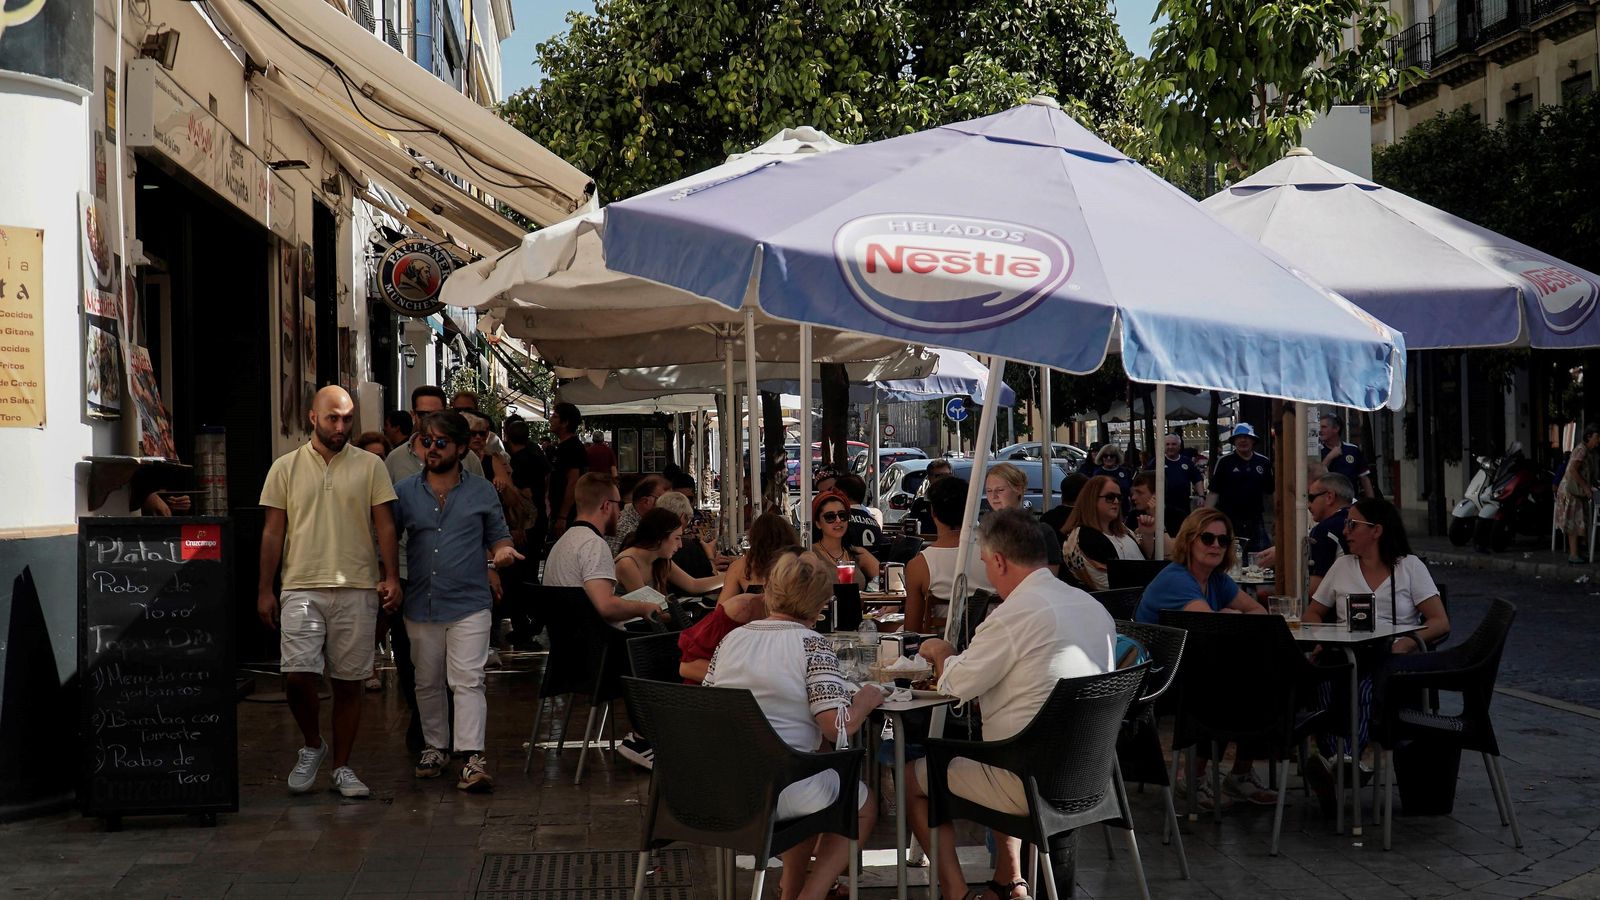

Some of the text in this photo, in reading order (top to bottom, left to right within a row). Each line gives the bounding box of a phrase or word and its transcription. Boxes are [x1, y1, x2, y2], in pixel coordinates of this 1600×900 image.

[888, 220, 1027, 243] HELADOS
[388, 243, 452, 280] PAULANER
[384, 283, 439, 310] MÜNCHEN
[5, 327, 34, 336] Gitana
[1, 345, 31, 353] ocidas
[10, 380, 38, 388] Cerdo
[10, 396, 35, 404] Salsa
[172, 743, 196, 767] de
